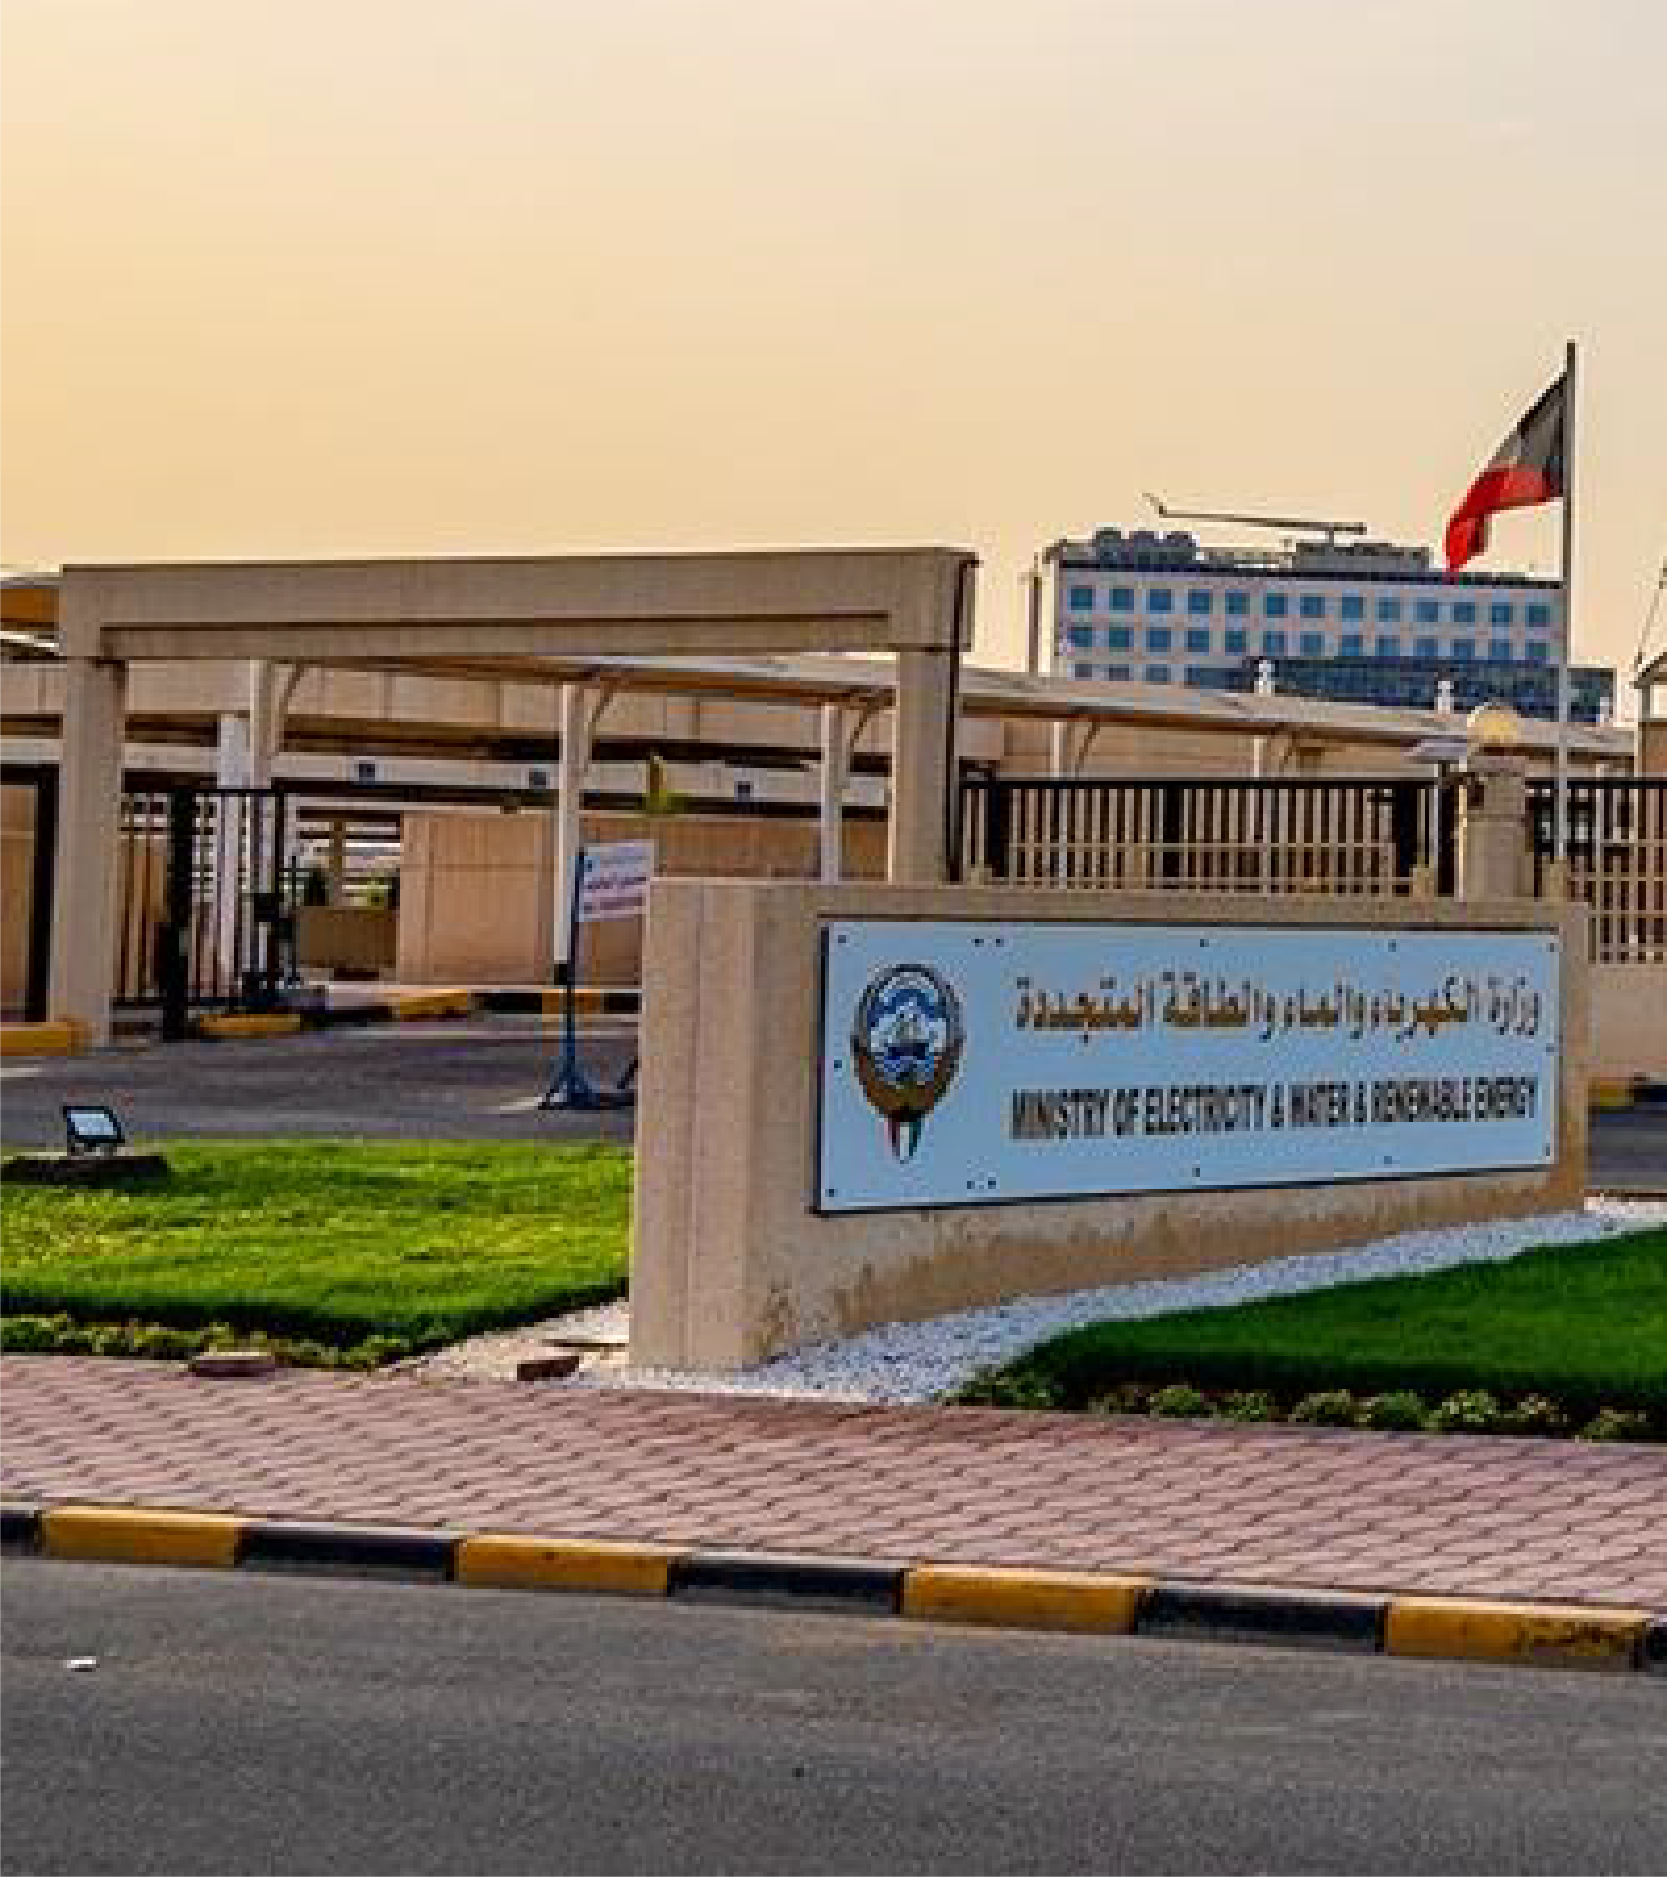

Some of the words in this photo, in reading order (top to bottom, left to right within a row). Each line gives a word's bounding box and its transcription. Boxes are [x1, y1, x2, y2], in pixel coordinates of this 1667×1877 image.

[1014, 975, 1156, 1044] المتجددة
[1161, 970, 1277, 1040] والطاقة
[1284, 979, 1366, 1040] والماء
[1372, 972, 1482, 1044] الكهرباء
[1487, 975, 1541, 1037] وزارة
[1011, 1087, 1109, 1140] MINISTRY
[1114, 1087, 1139, 1135] OF
[1144, 1082, 1266, 1134] ELECTRICITY
[1289, 1080, 1350, 1128] WATER
[1476, 1074, 1538, 1120] ENERGY
